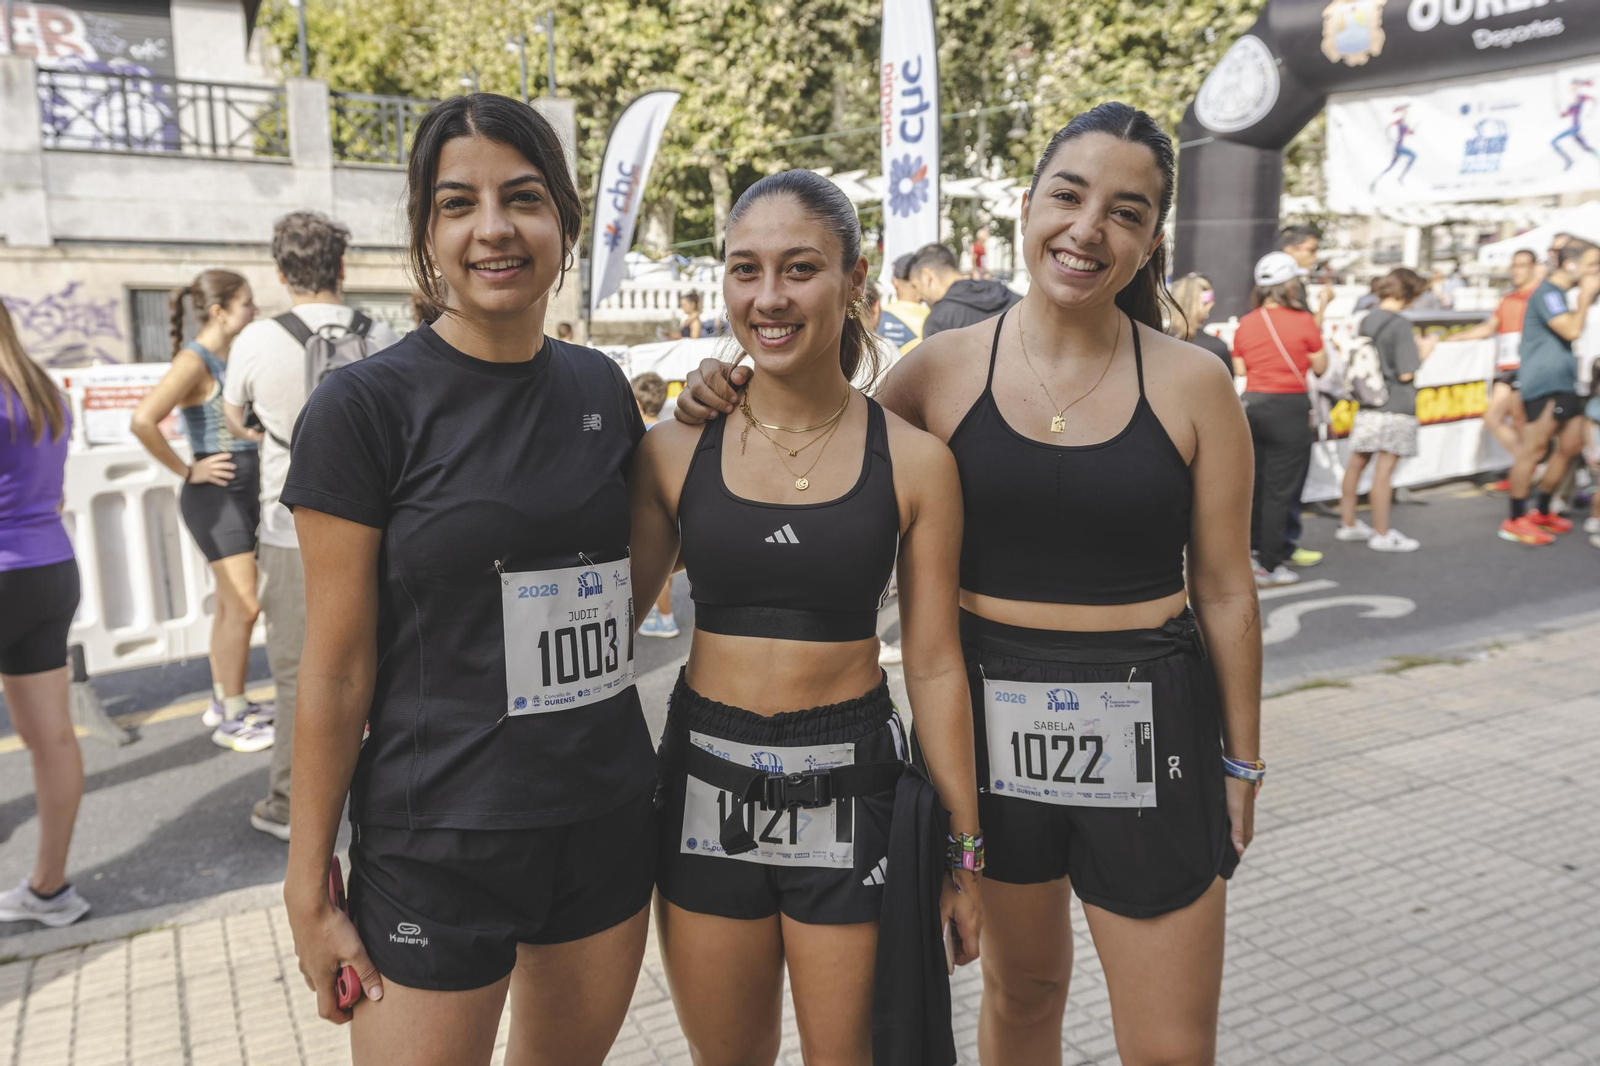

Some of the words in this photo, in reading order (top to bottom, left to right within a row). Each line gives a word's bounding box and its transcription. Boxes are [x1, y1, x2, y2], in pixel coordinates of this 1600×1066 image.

[1472, 17, 1565, 50] Deportes
[607, 161, 637, 212] chc
[517, 583, 559, 598] 2026
[568, 607, 599, 622] JUDIT
[537, 617, 619, 687] 1003
[544, 695, 576, 706] OURENSE
[994, 691, 1027, 704] 2026
[1033, 720, 1075, 731] SABELA
[1011, 731, 1105, 784] 1022
[1016, 787, 1042, 797] OURENSE
